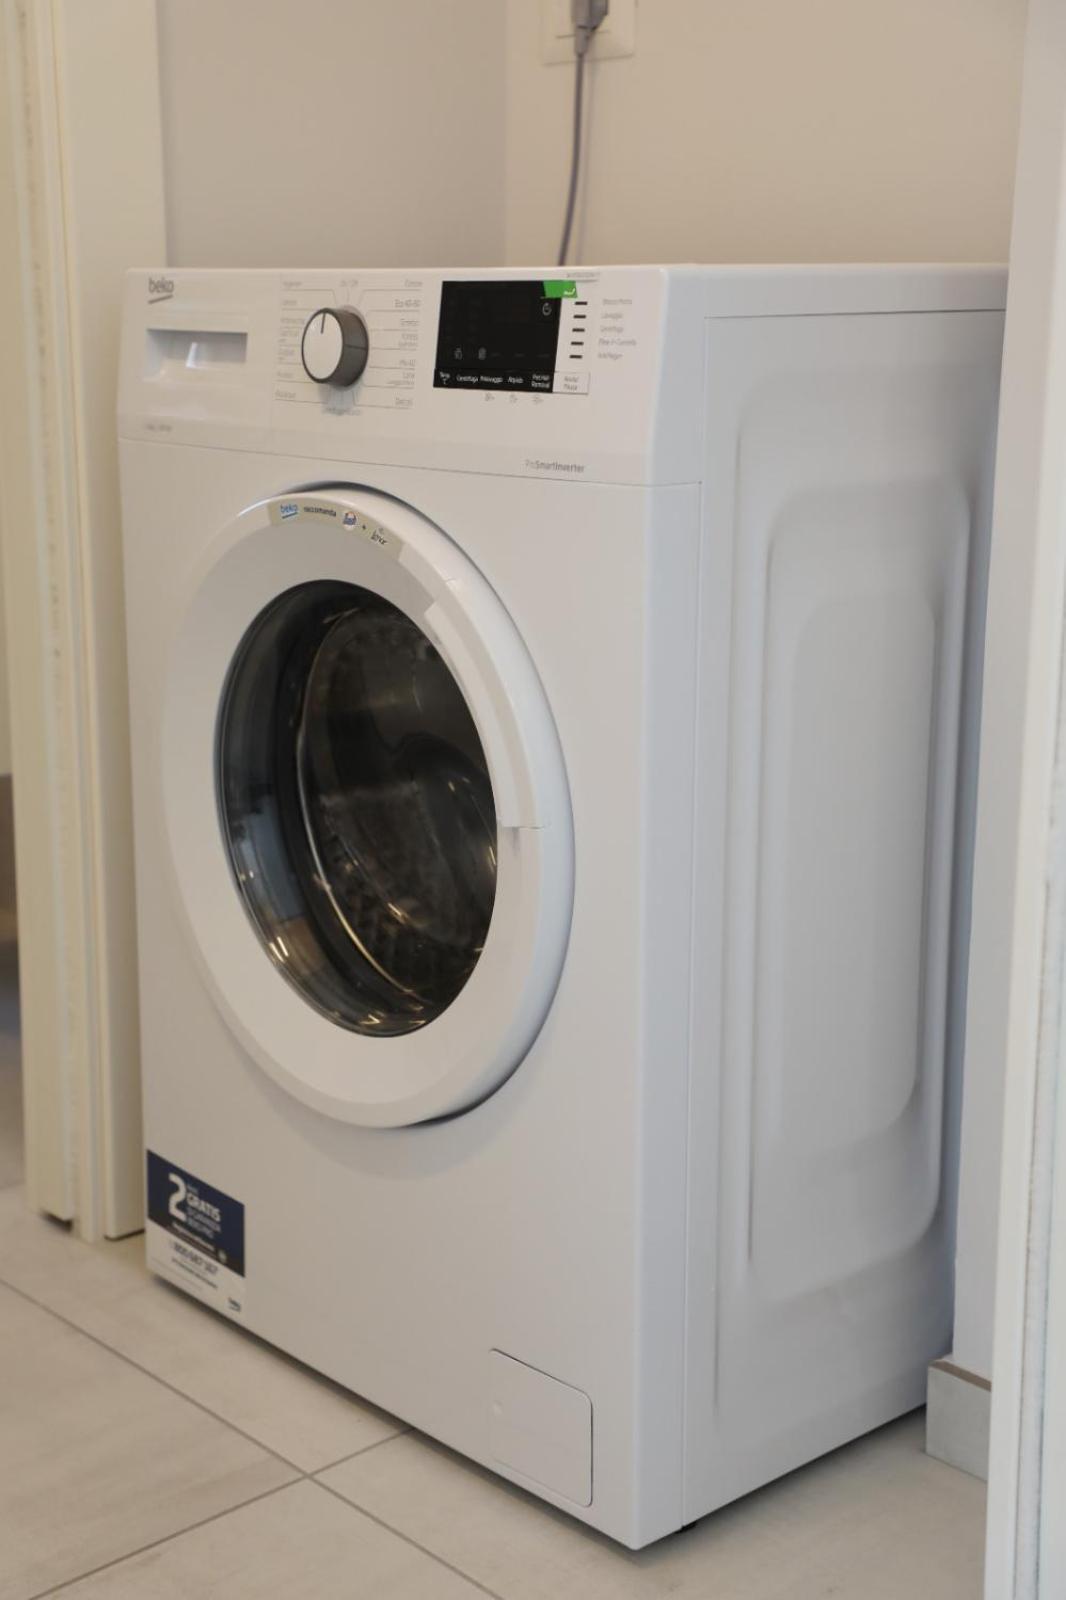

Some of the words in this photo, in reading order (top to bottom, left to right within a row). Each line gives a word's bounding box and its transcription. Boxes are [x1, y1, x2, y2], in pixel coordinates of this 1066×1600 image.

[148, 278, 174, 297] beko
[280, 504, 298, 517] beko
[168, 1172, 188, 1223] 2
[186, 1191, 221, 1223] GRATIS
